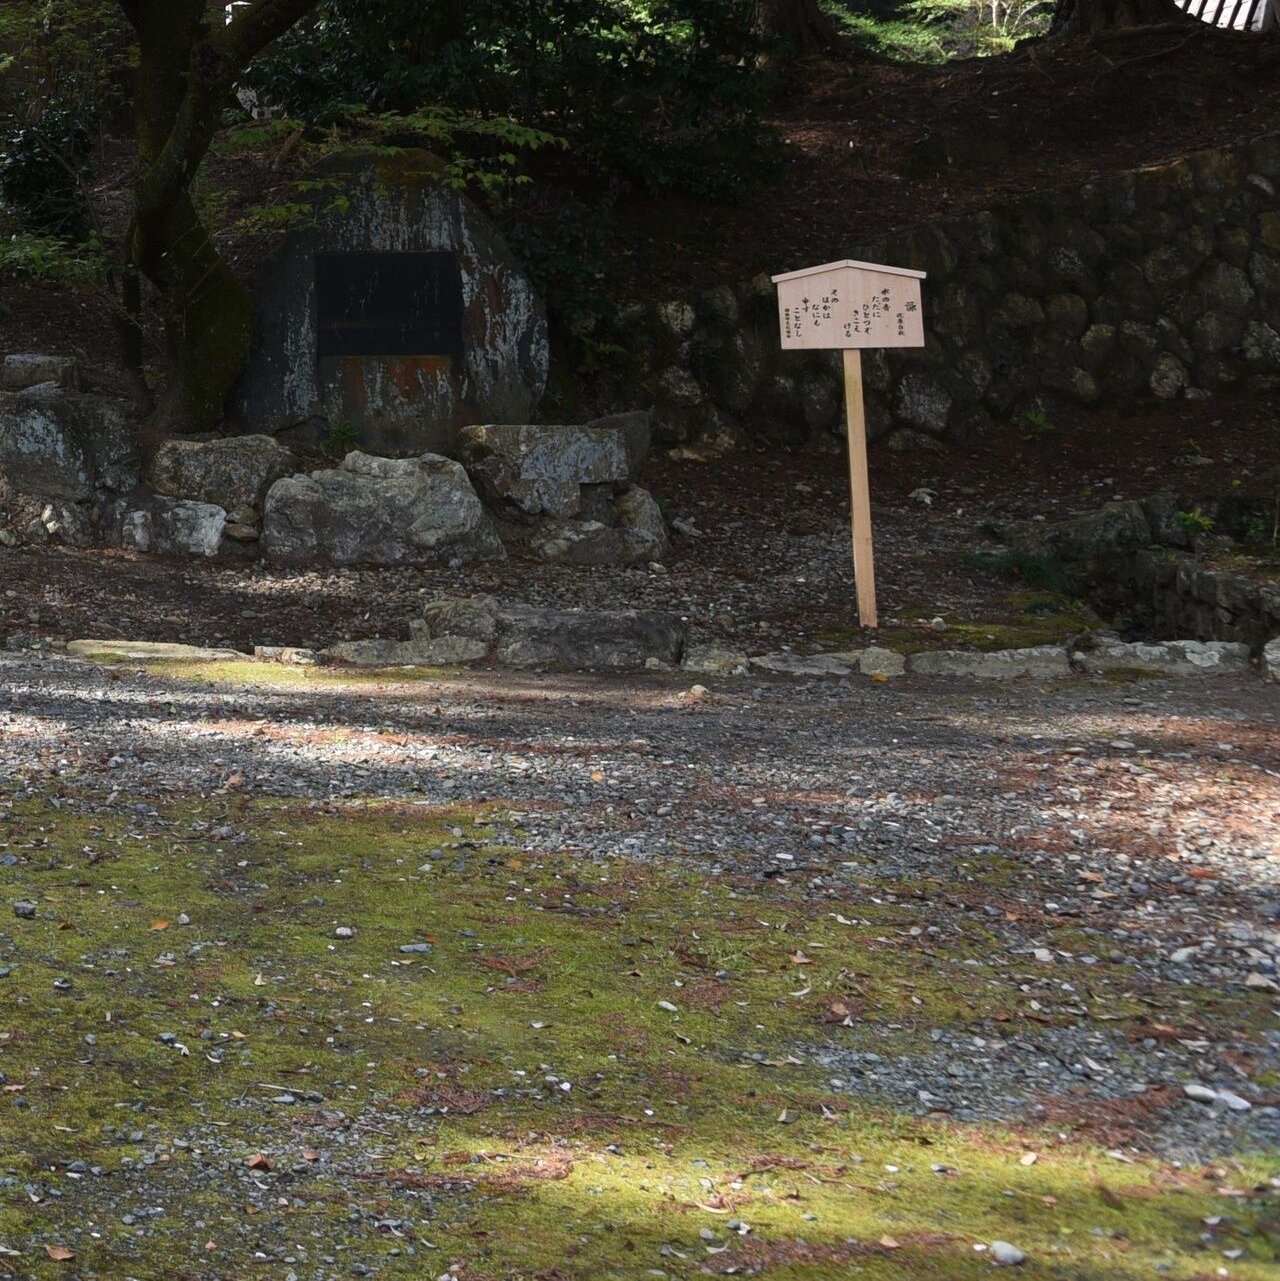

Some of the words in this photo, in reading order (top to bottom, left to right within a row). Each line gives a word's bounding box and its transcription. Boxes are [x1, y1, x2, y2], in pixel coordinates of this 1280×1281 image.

[831, 288, 840, 304] その
[881, 287, 891, 312] 水の音
[812, 304, 821, 327] なにも
[822, 297, 831, 319] ほかは
[793, 307, 803, 338] ことなし
[843, 322, 852, 338] ける
[853, 309, 861, 333] きこえ
